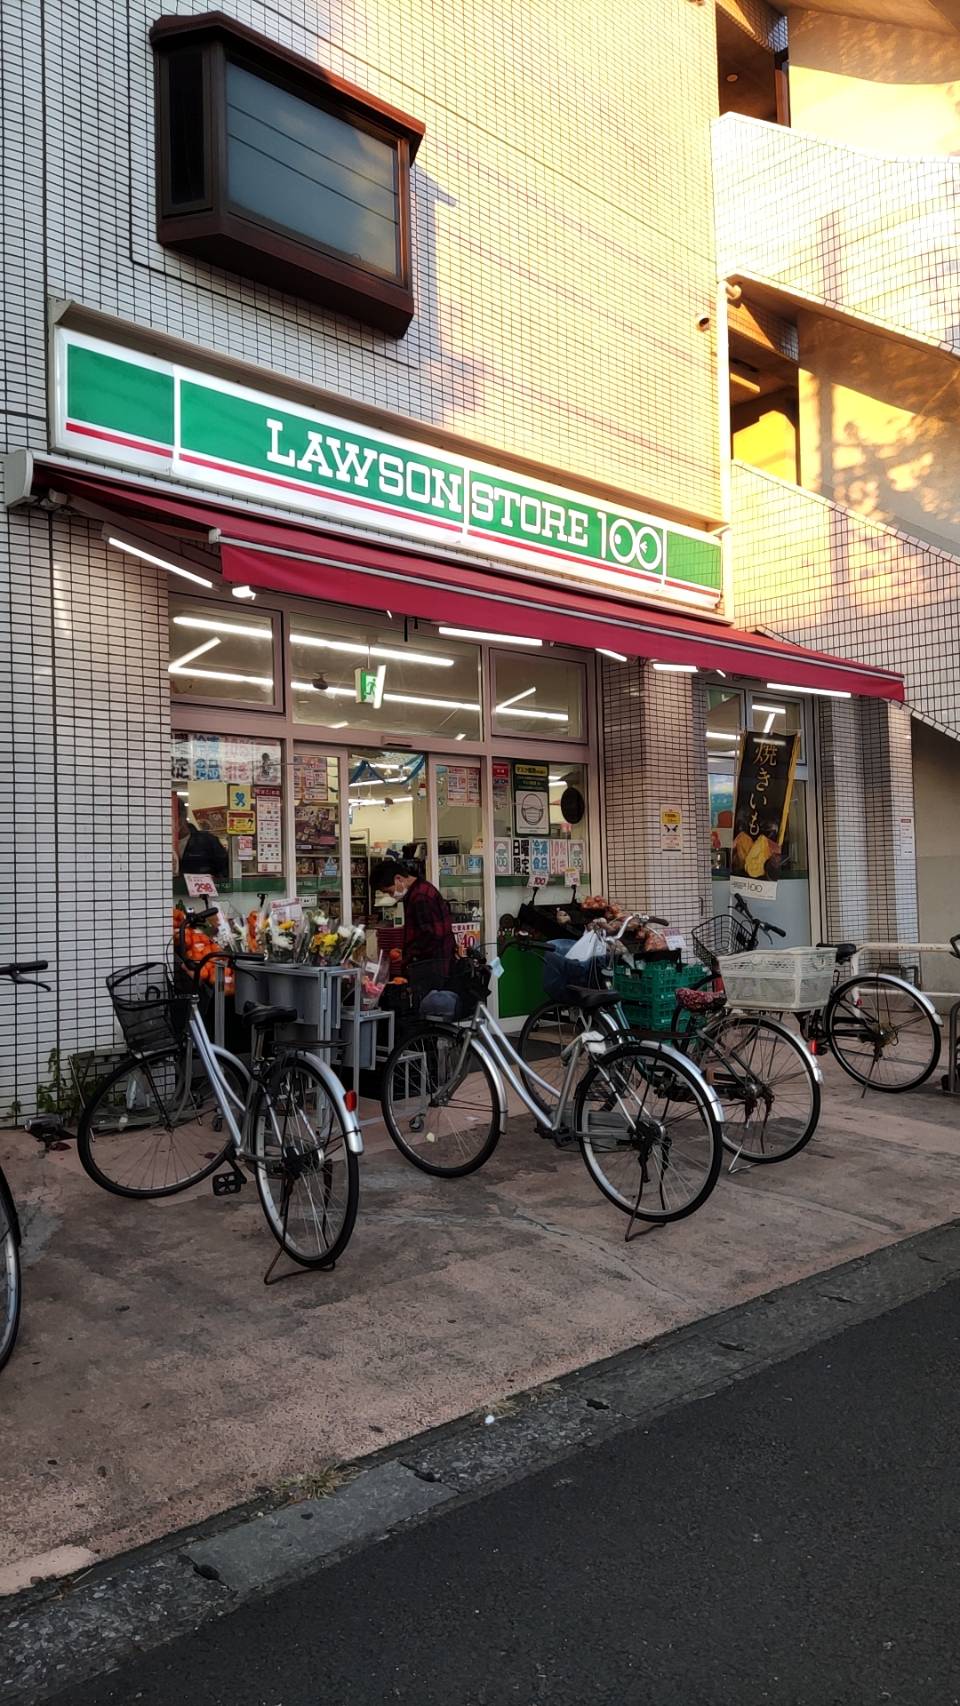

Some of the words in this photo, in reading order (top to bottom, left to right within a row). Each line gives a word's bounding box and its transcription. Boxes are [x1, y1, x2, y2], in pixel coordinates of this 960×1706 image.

[266, 418, 463, 513] LAWSON
[471, 481, 588, 547] STORE
[597, 511, 662, 570] 100
[749, 742, 778, 836] 焼きいも
[194, 882, 214, 893] 298
